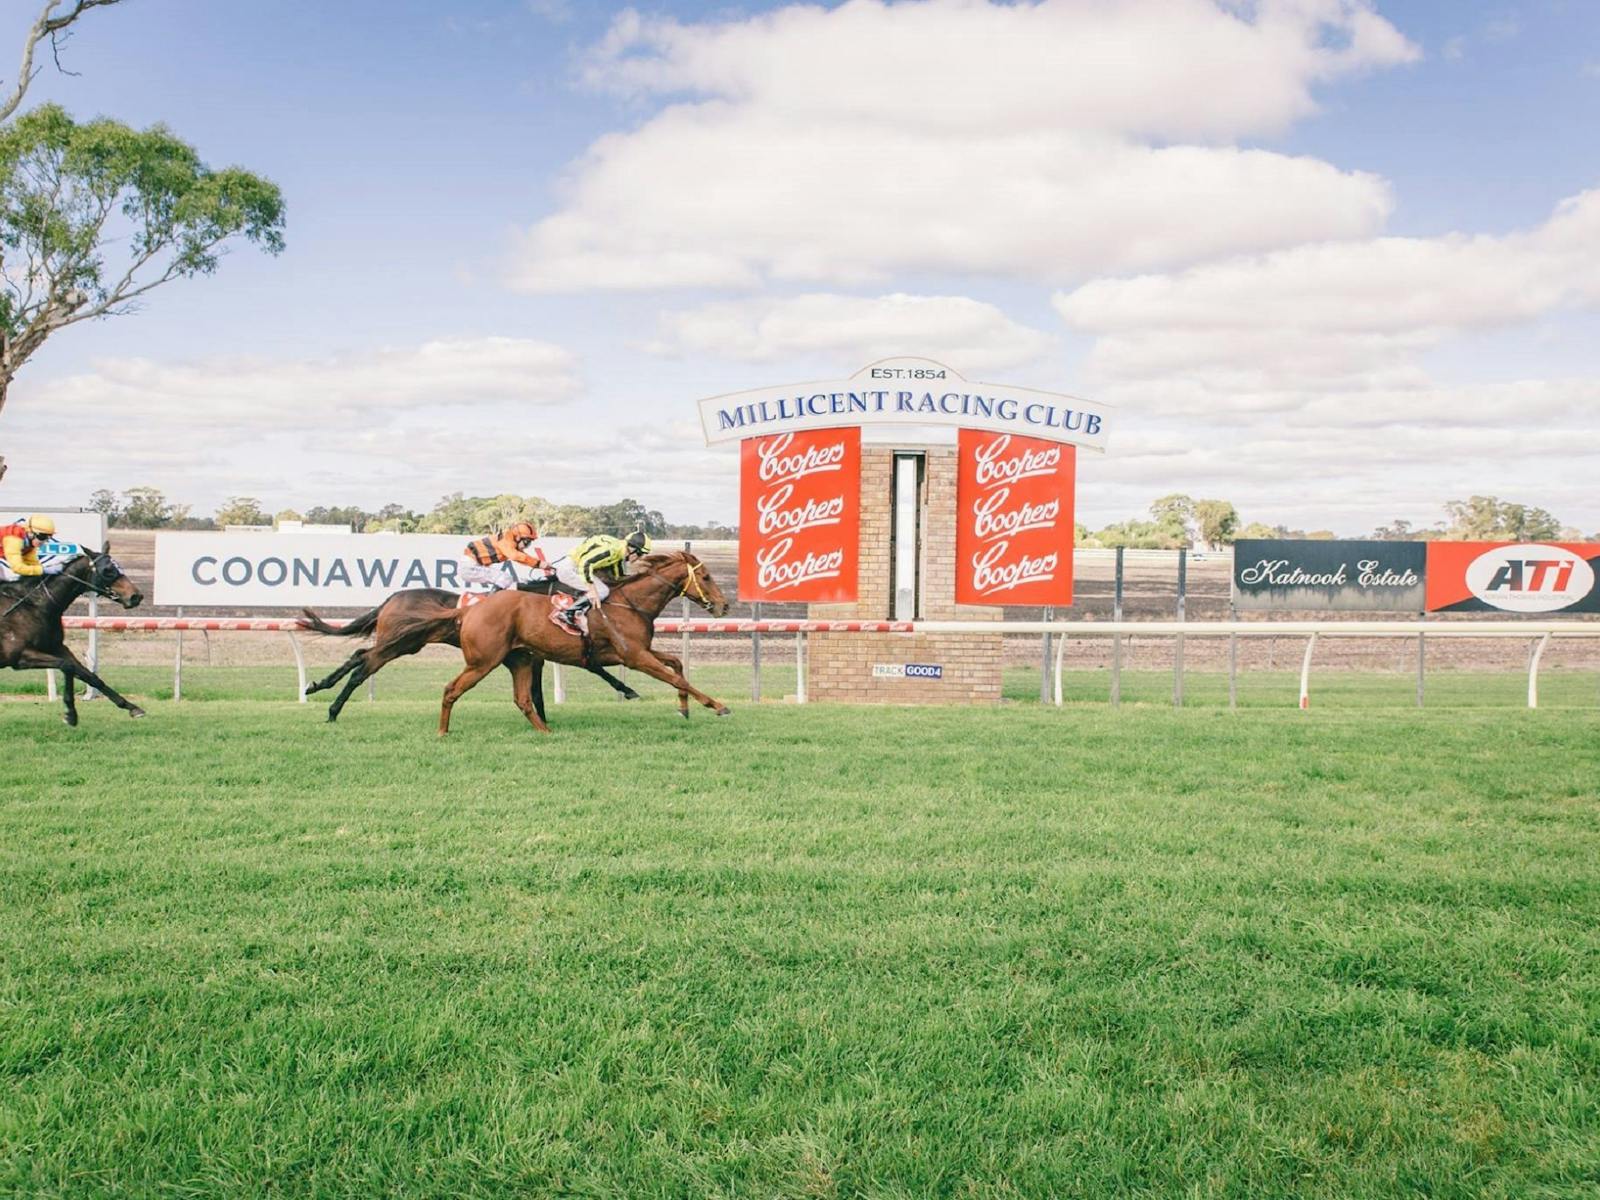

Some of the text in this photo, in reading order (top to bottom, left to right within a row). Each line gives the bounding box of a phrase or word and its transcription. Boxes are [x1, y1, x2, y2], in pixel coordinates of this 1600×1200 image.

[717, 391, 1102, 435] MILLICENT RACING CLUB
[758, 432, 845, 483] Coopers
[974, 435, 1061, 487] Coopers
[757, 484, 844, 537] Coopers
[973, 488, 1060, 540] Coopers
[191, 556, 518, 588] COONAWARA
[756, 537, 843, 590] Coopers
[972, 541, 1058, 593] Coopers
[1241, 559, 1418, 588] Katnook Estate
